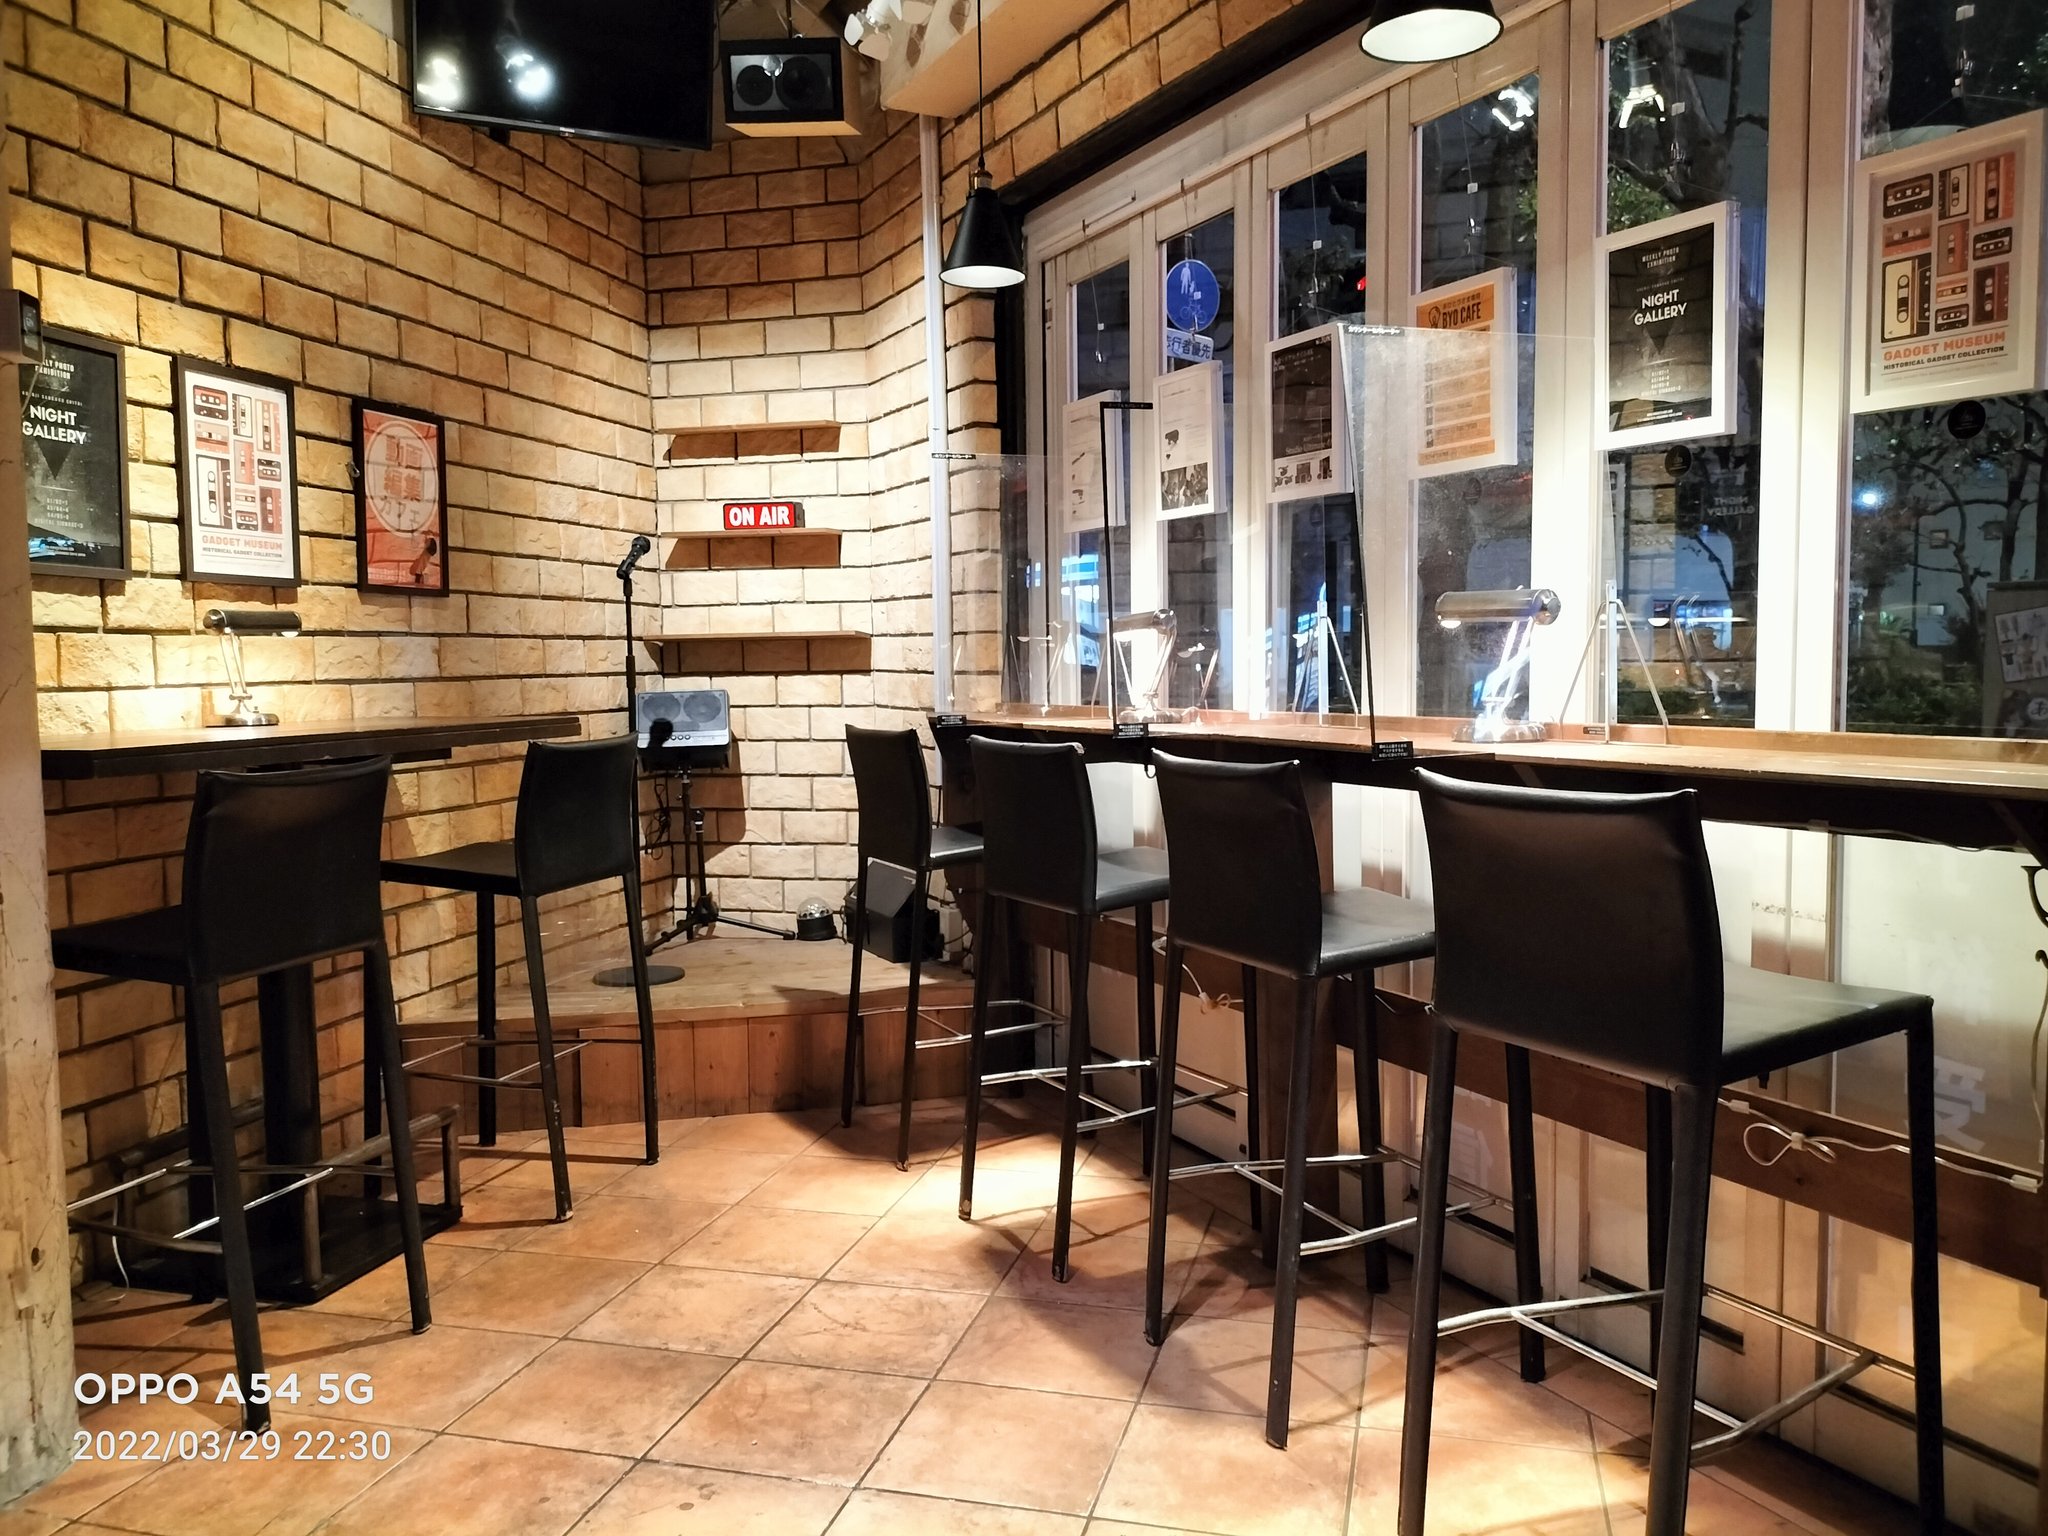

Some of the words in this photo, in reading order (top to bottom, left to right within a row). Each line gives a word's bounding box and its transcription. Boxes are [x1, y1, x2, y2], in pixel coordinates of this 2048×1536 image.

[1641, 289, 1679, 309] NIGHT
[1442, 308, 1459, 329] BYO
[1460, 302, 1482, 324] CAFE
[1634, 302, 1687, 325] GALLERY
[1883, 343, 1939, 362] GADGET
[1943, 331, 2006, 351] MUSEUM
[1883, 358, 1925, 370] HISTORICAL
[1927, 353, 1956, 363] GADGET
[1957, 346, 2005, 359] COLLECTION
[29, 404, 77, 426] NIGHT
[22, 421, 87, 444] GALLERY
[729, 507, 755, 526] ON
[759, 505, 791, 525] AIR
[202, 535, 240, 547] GADGET
[243, 540, 282, 550] MUSEUM
